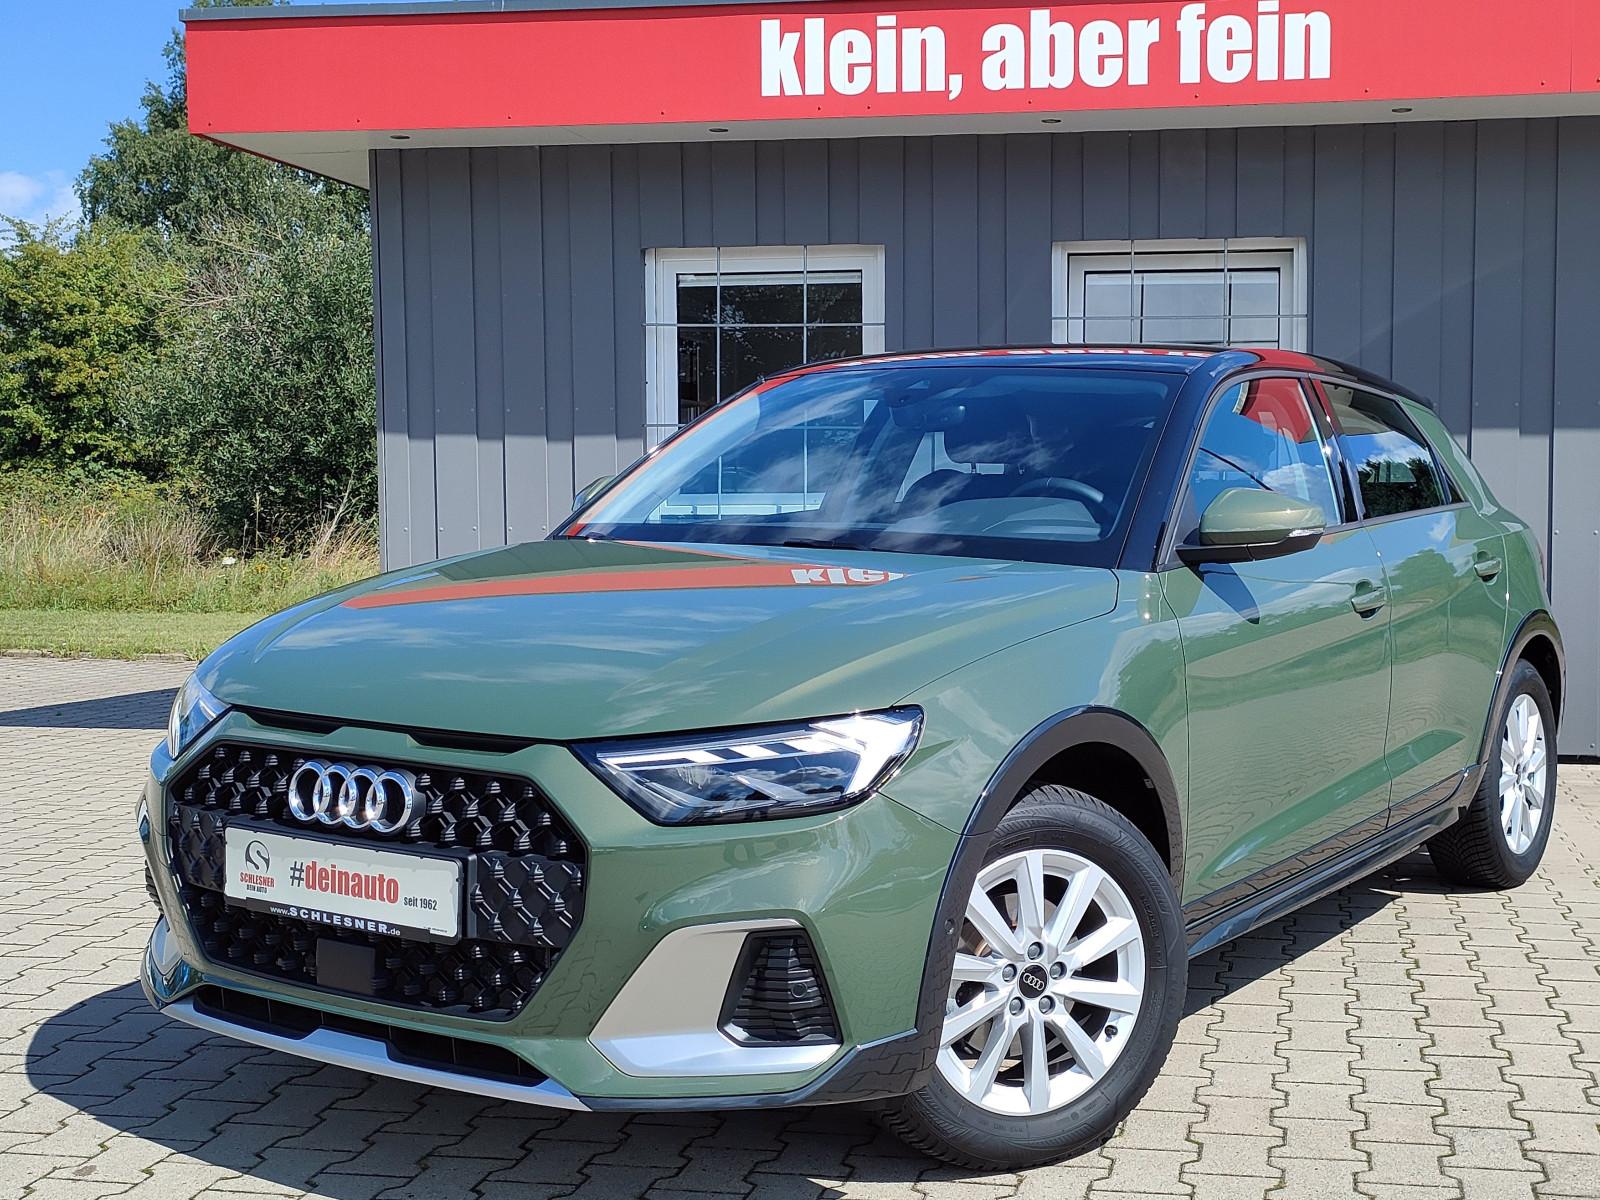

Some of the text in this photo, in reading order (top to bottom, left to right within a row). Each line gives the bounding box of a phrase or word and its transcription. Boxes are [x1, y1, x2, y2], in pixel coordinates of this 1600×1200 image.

[760, 0, 1332, 101] klein, aber fein
[239, 871, 275, 888] SCHLESNER
[289, 860, 399, 904] #deinauto
[403, 896, 438, 911] seit 1962
[270, 905, 401, 936] www.SCHLESNER.de
